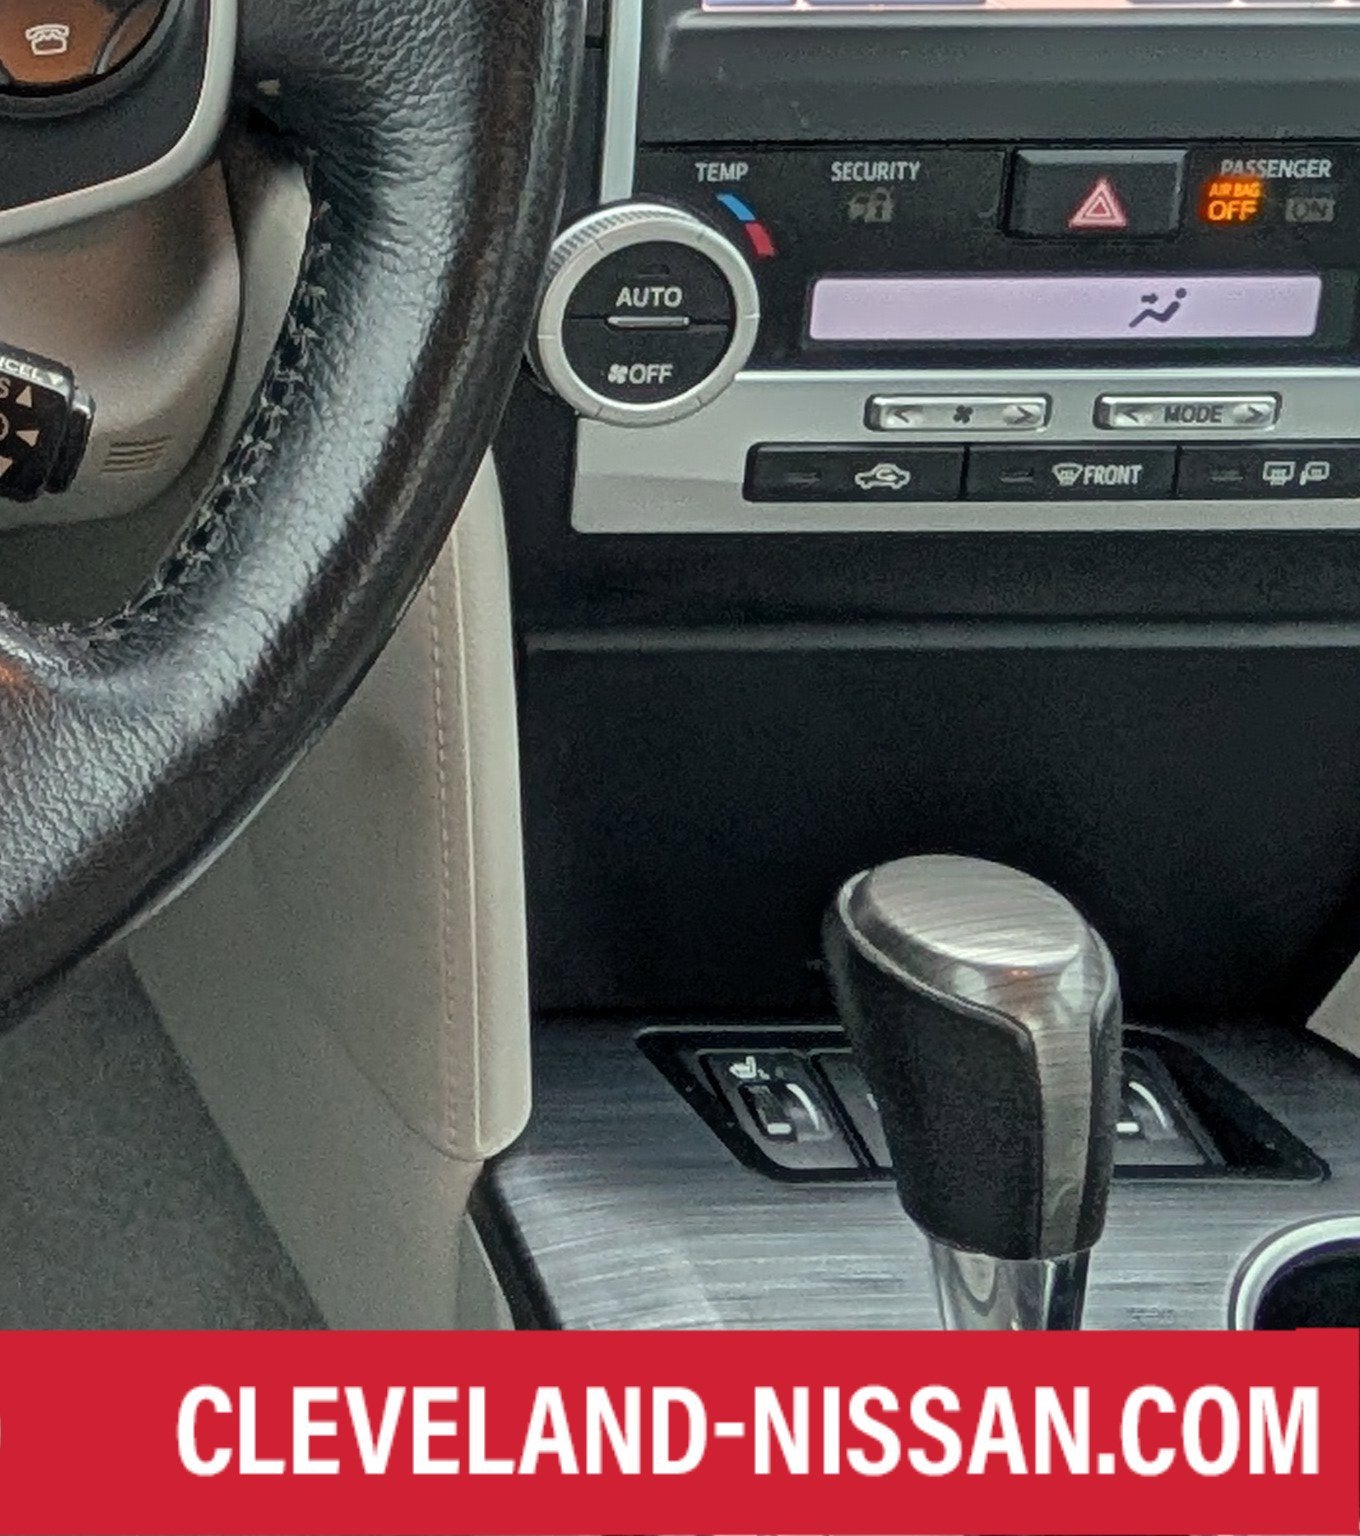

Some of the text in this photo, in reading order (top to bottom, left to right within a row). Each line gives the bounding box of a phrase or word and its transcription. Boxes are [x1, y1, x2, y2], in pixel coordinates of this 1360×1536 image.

[695, 161, 750, 182] TEMP
[830, 160, 921, 182] SECURITY
[1220, 158, 1332, 178] PASSENGER
[1208, 181, 1262, 198] AIR BAG
[1207, 199, 1258, 221] OFF
[615, 286, 683, 307] AUTO
[629, 364, 673, 384] OFF
[1164, 404, 1224, 424] MODE
[1083, 464, 1144, 485] FRONT
